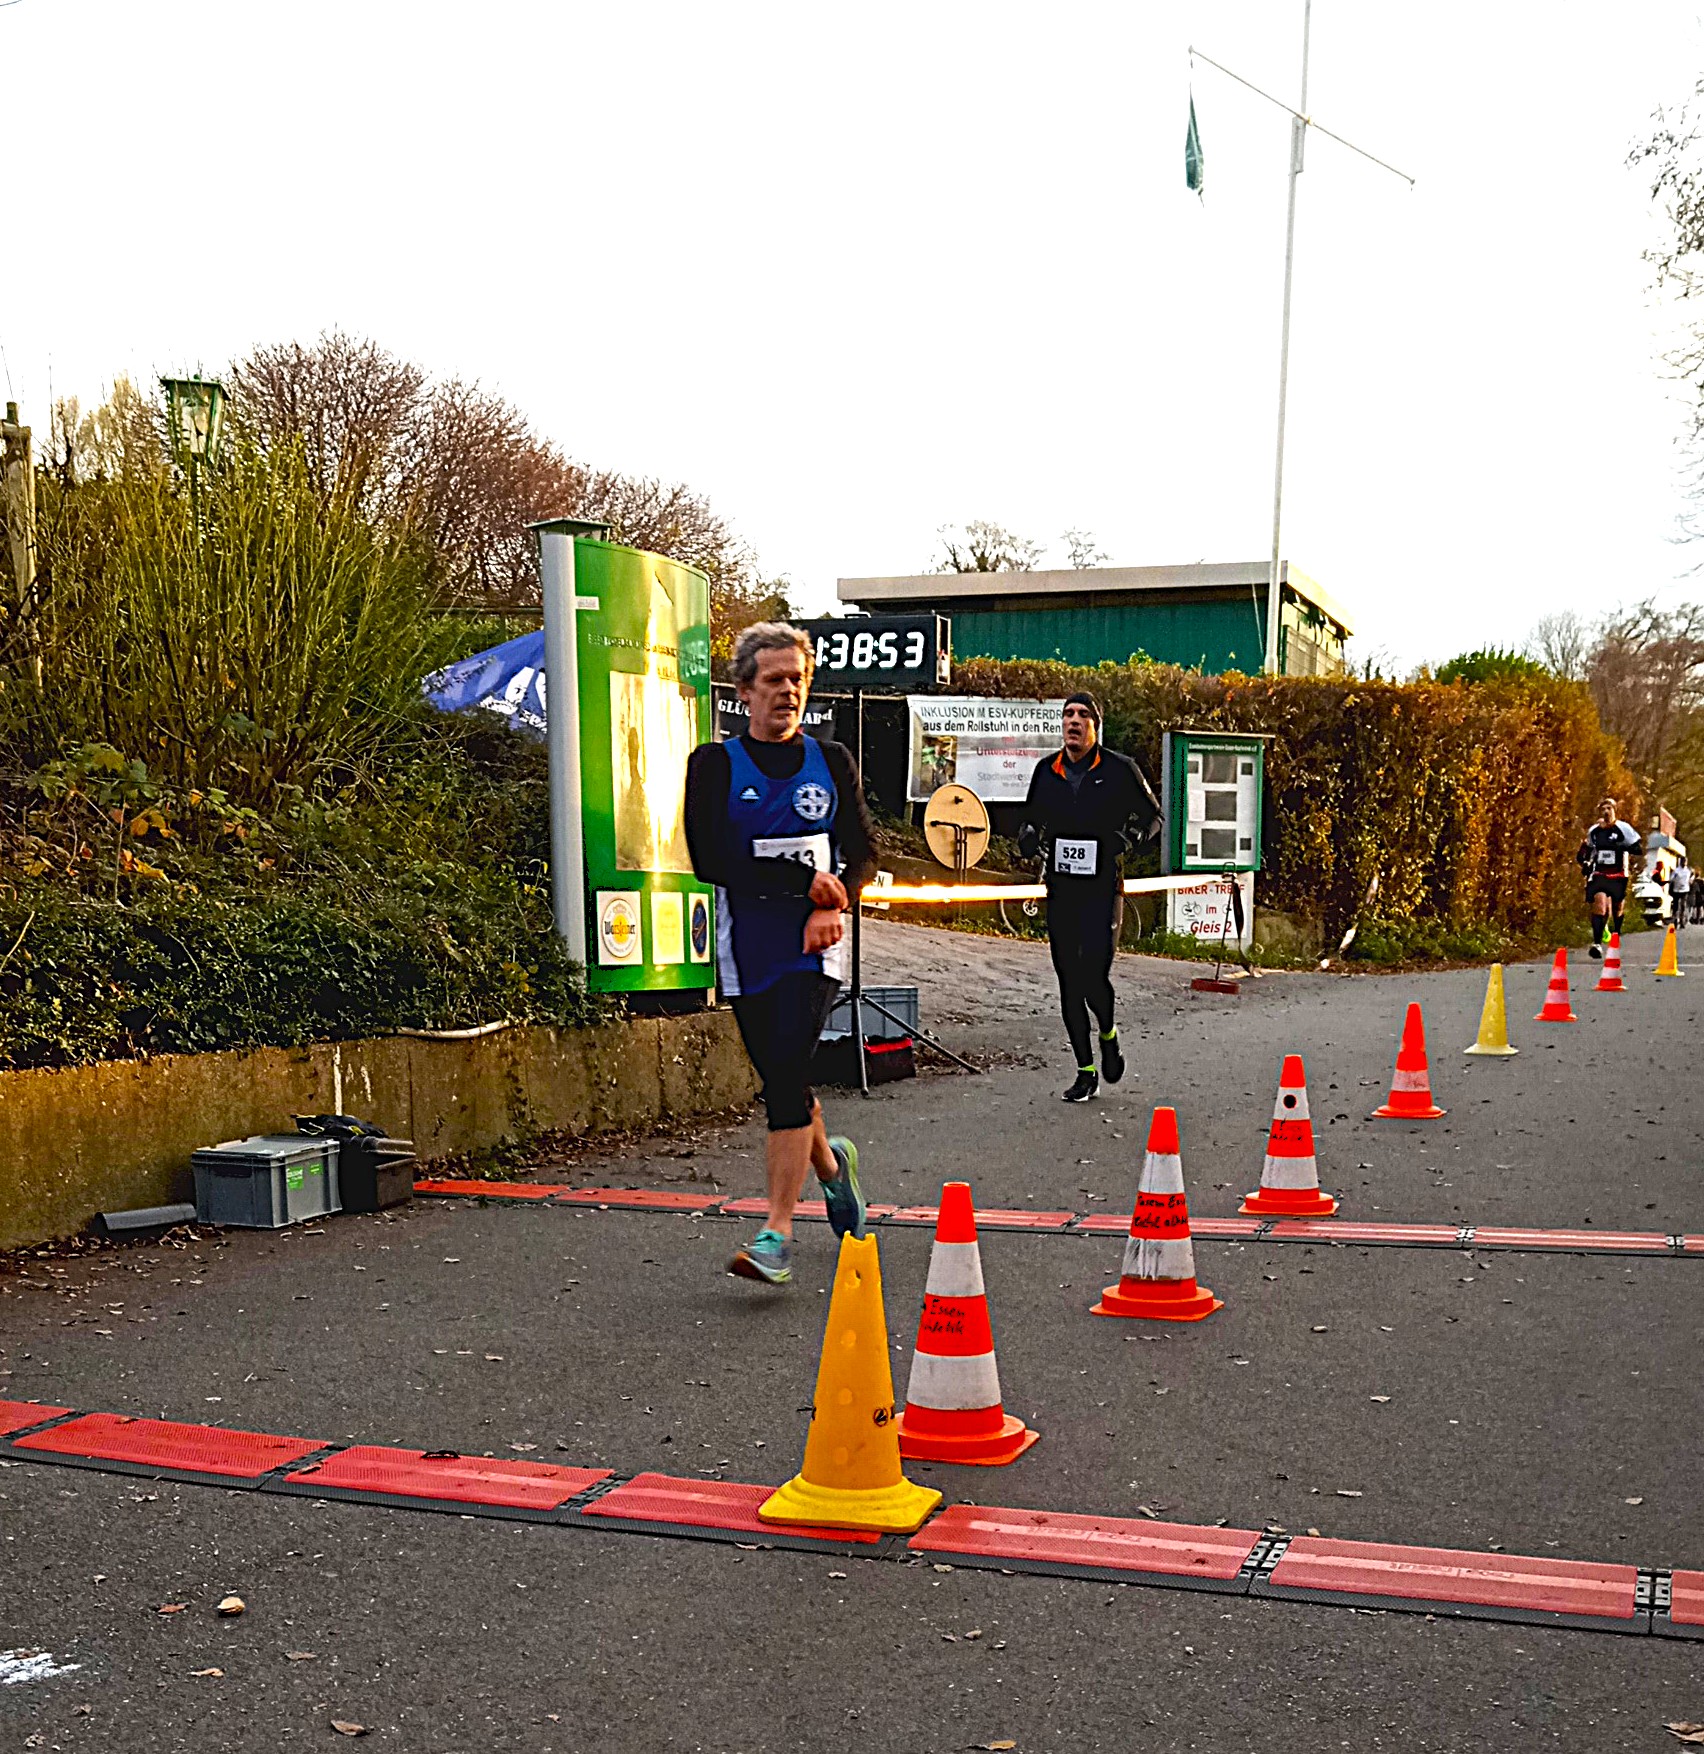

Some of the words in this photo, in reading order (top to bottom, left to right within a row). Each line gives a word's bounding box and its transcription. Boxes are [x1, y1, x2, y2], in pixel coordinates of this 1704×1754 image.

[921, 707, 975, 718] INKLUSION
[923, 722, 941, 732] aus
[944, 720, 965, 732] dem
[967, 720, 1009, 733] Rollstuhl
[1011, 722, 1020, 733] in
[1022, 721, 1040, 733] den
[1043, 722, 1061, 734] Ren
[1002, 759, 1017, 769] der
[1063, 846, 1086, 860] 528
[1178, 884, 1208, 895] BIKER
[1205, 904, 1217, 914] im
[1190, 920, 1221, 933] Gleis
